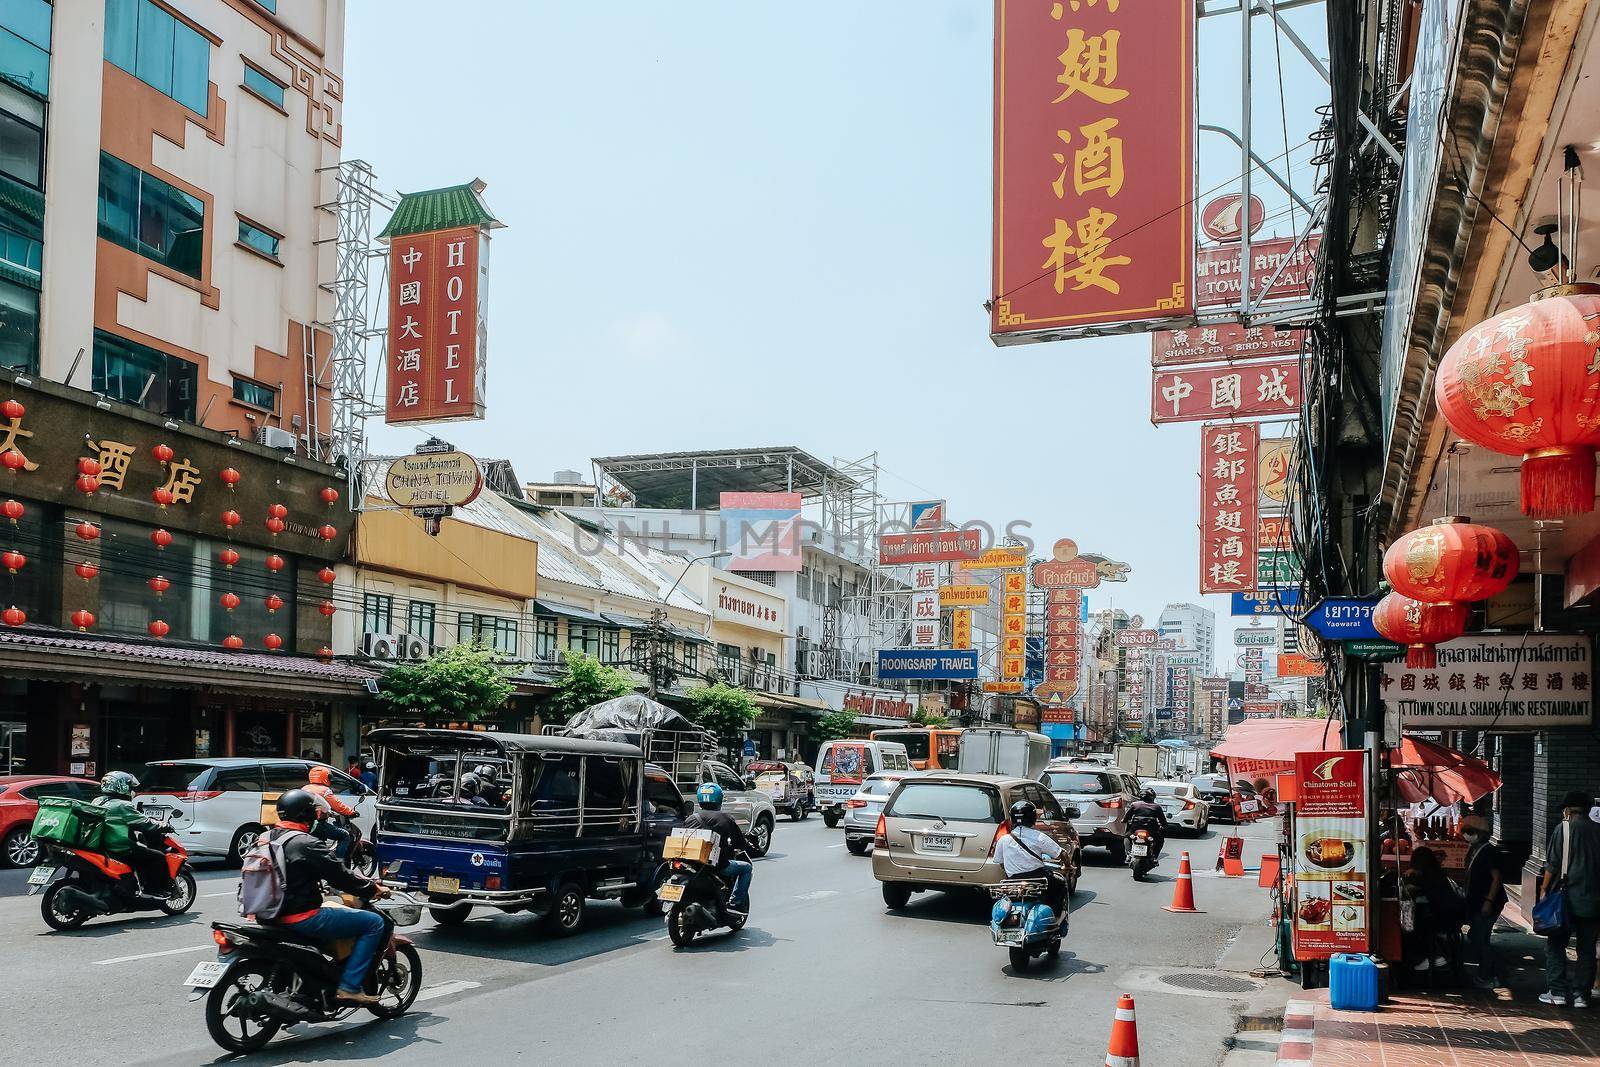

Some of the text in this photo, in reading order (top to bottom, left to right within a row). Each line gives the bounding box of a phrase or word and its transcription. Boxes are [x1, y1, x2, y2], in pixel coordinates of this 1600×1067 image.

[1041, 0, 1133, 295] 翅酒樓
[396, 247, 424, 408] 中國大酒店
[444, 241, 466, 404] HOTEL
[1165, 347, 1204, 358] SHARK'S
[1236, 342, 1268, 351] BIRD'S
[1271, 338, 1297, 348] NEST
[1162, 368, 1295, 416] 中國城
[392, 470, 473, 489] CHINA TOWN
[411, 490, 450, 501] HOTEL
[1210, 432, 1248, 585] 銀都魚翅酒樓
[881, 658, 975, 670] ROONGSARP TRAVEL
[1409, 701, 1434, 716] TOWN
[1437, 701, 1467, 716] SCALA
[1527, 701, 1590, 716] RESTAURANT
[1339, 780, 1357, 788] Scala
[935, 837, 951, 845] 5495
